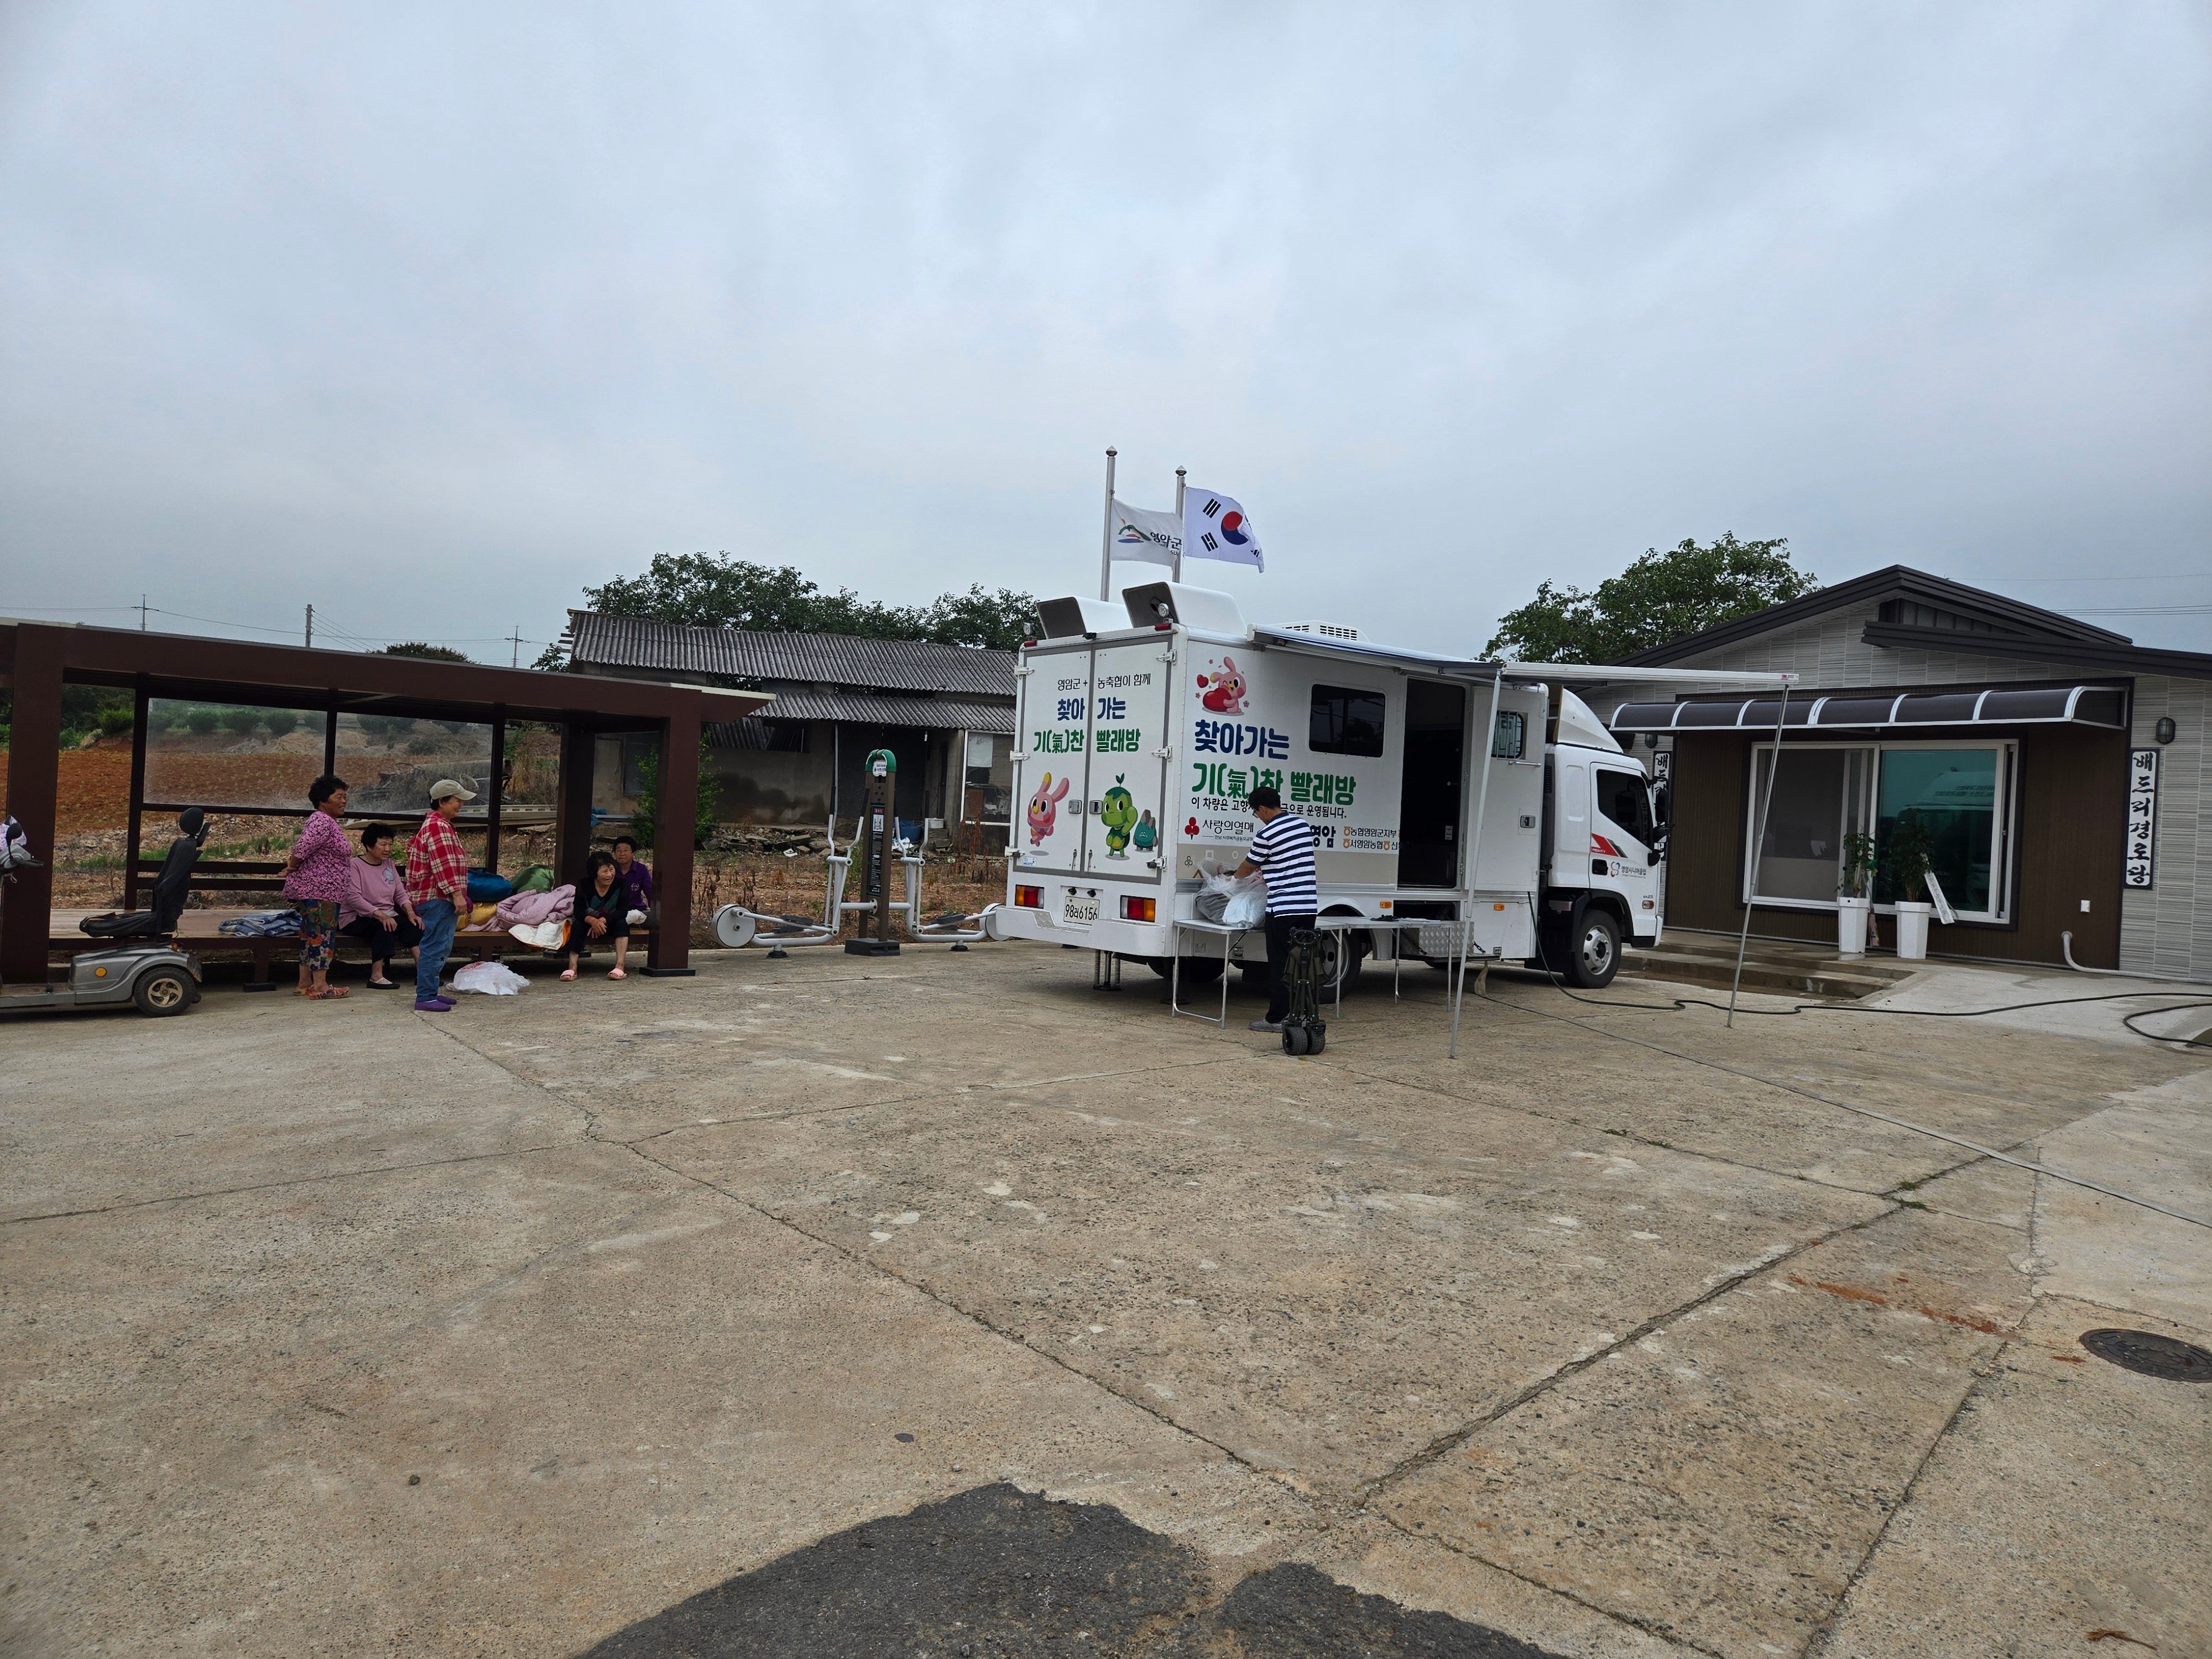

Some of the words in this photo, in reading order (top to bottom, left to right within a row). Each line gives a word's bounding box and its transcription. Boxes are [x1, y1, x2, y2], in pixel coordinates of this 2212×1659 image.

[1057, 679, 1081, 691] 영암군
[1098, 675, 1130, 689] 농축협이
[1134, 673, 1151, 686] 함께
[1057, 697, 1085, 721] 찾아
[1097, 697, 1126, 720] 가는
[1033, 729, 1084, 754] 기(氣)찬
[1096, 728, 1141, 753] 빨래방
[1194, 719, 1290, 760] 찾아가는
[1290, 771, 1357, 806] 빨래방
[1191, 797, 1199, 809] 이
[1203, 797, 1229, 811] 차량은
[1306, 805, 1347, 819] 운영됩니다.
[1202, 820, 1254, 835] 사랑의열매
[1310, 825, 1337, 848] 영암
[1350, 827, 1397, 838] 농협영암군지부
[1350, 839, 1383, 849] 서영암농협
[1065, 904, 1098, 921] 98러6156
